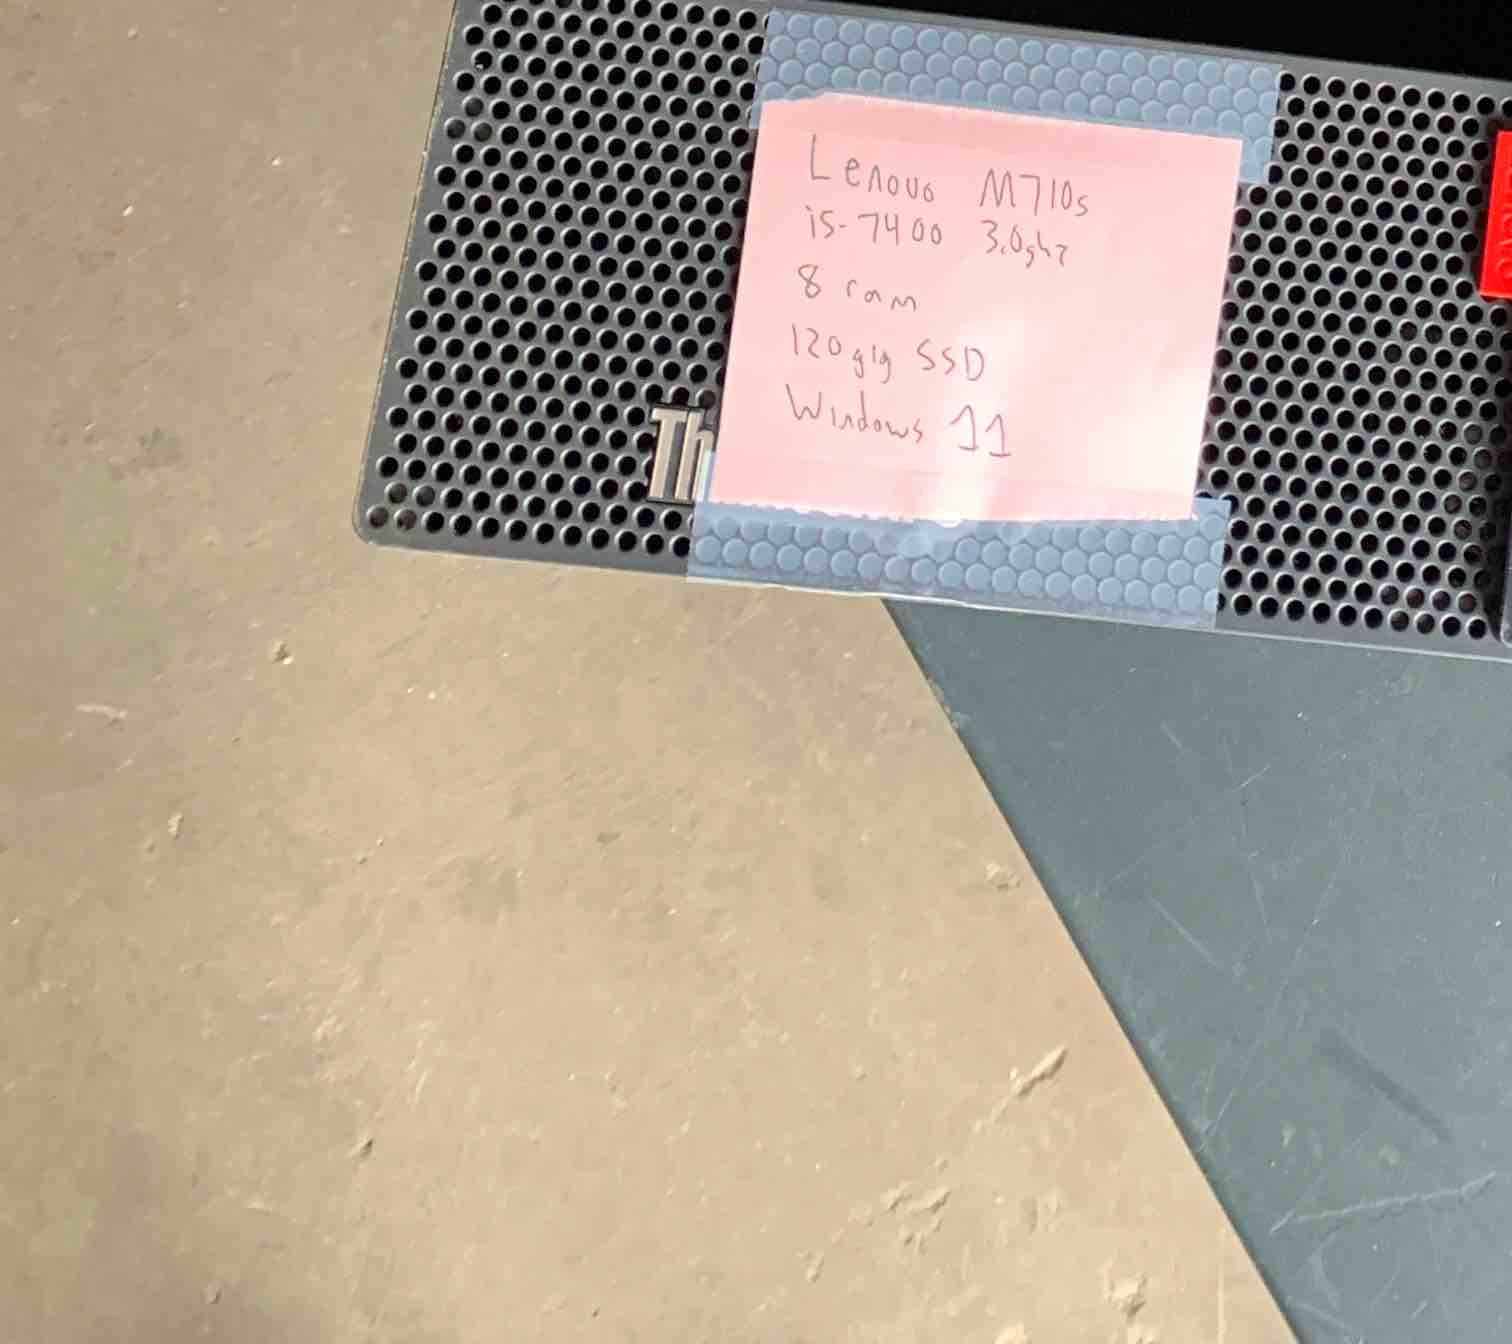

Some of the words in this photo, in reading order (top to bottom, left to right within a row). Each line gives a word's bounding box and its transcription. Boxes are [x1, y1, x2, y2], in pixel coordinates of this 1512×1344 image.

[809, 134, 936, 203] Lenovo
[980, 168, 1089, 218] M710s
[805, 204, 944, 246] i5-7400
[799, 264, 820, 300] 8
[846, 280, 918, 312] ram
[791, 324, 842, 360] 120
[918, 341, 985, 381] SSD
[785, 383, 924, 444] Windows
[950, 404, 1011, 458] 11
